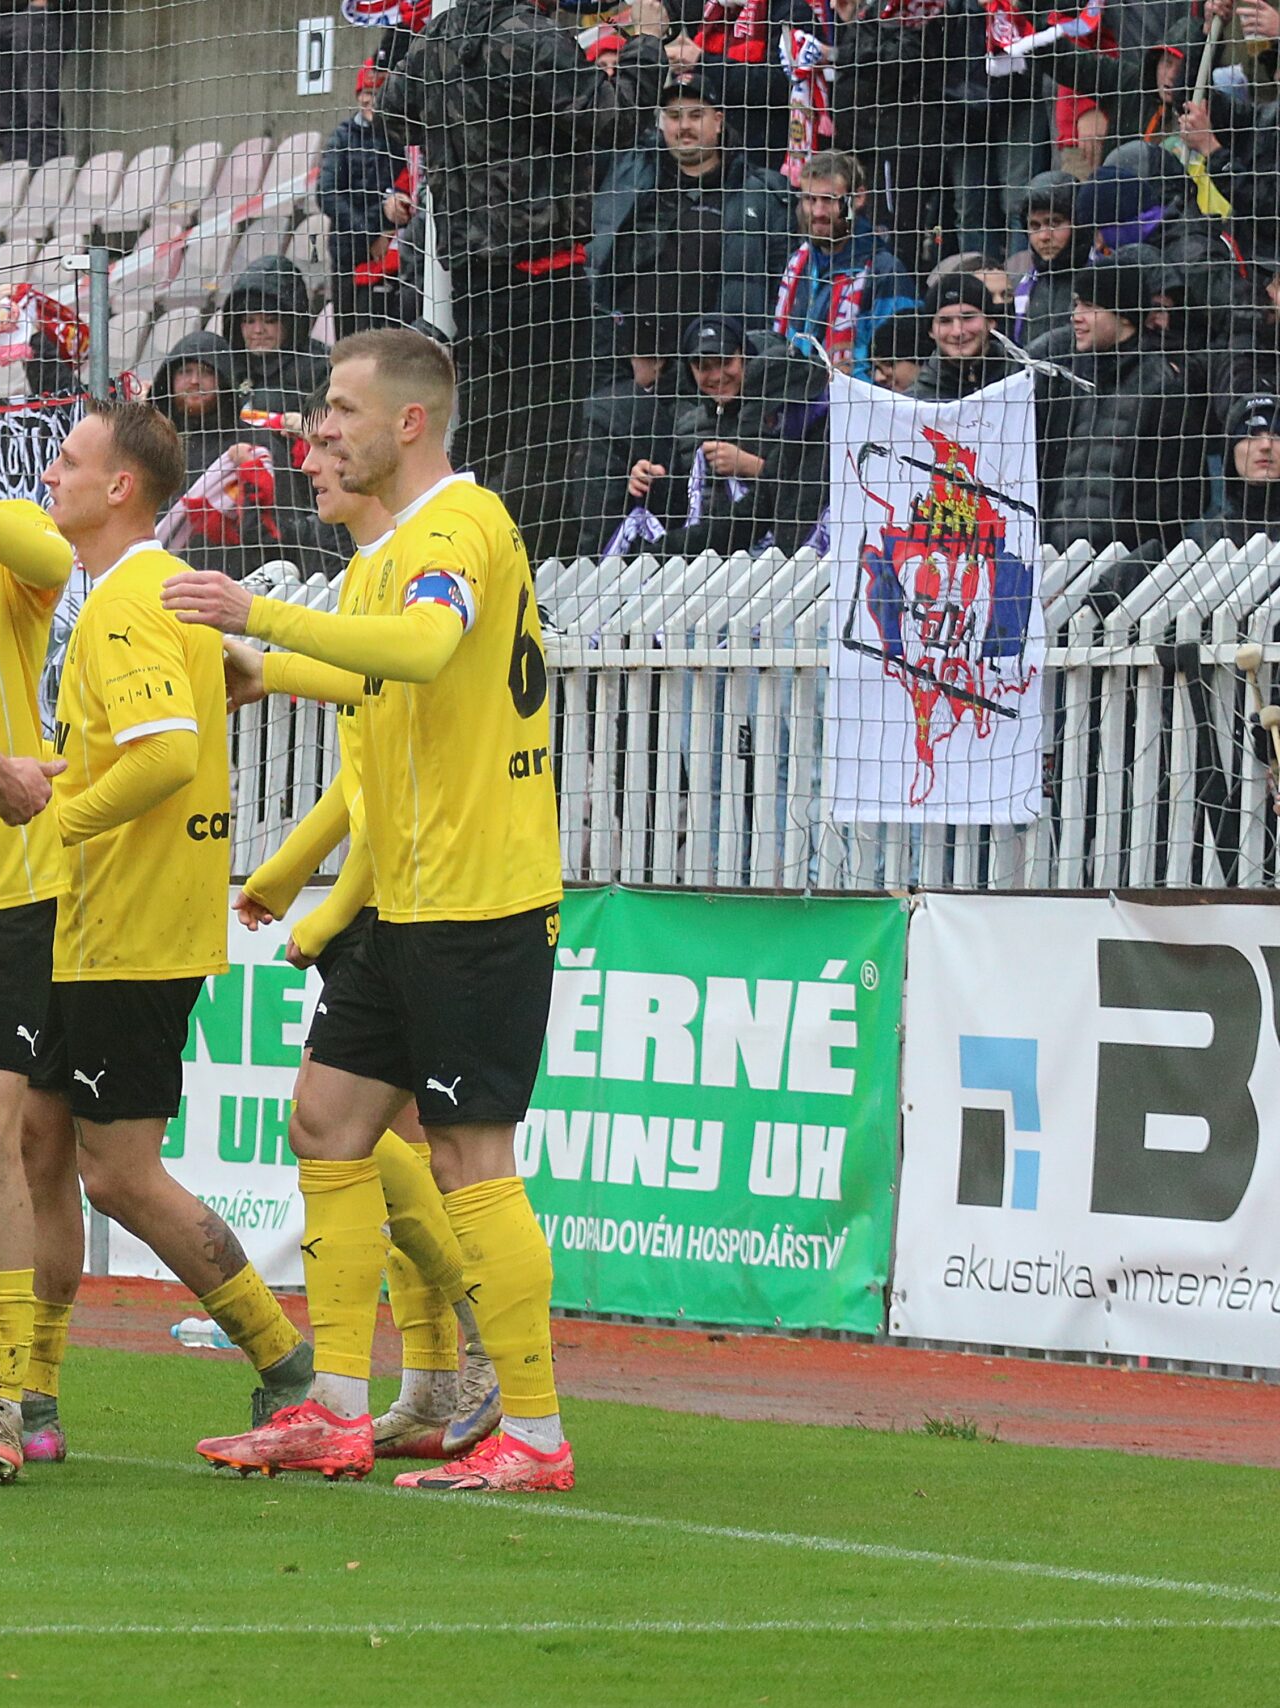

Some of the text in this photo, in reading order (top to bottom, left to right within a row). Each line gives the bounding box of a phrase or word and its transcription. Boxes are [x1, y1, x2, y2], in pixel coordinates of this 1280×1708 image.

[307, 32, 323, 80] D
[748, 1121, 847, 1200] UH
[562, 1213, 683, 1259] ODPADOVÉM
[686, 1222, 849, 1271] HOSPODÁŘSTVÍ
[943, 1243, 1097, 1298] akustika
